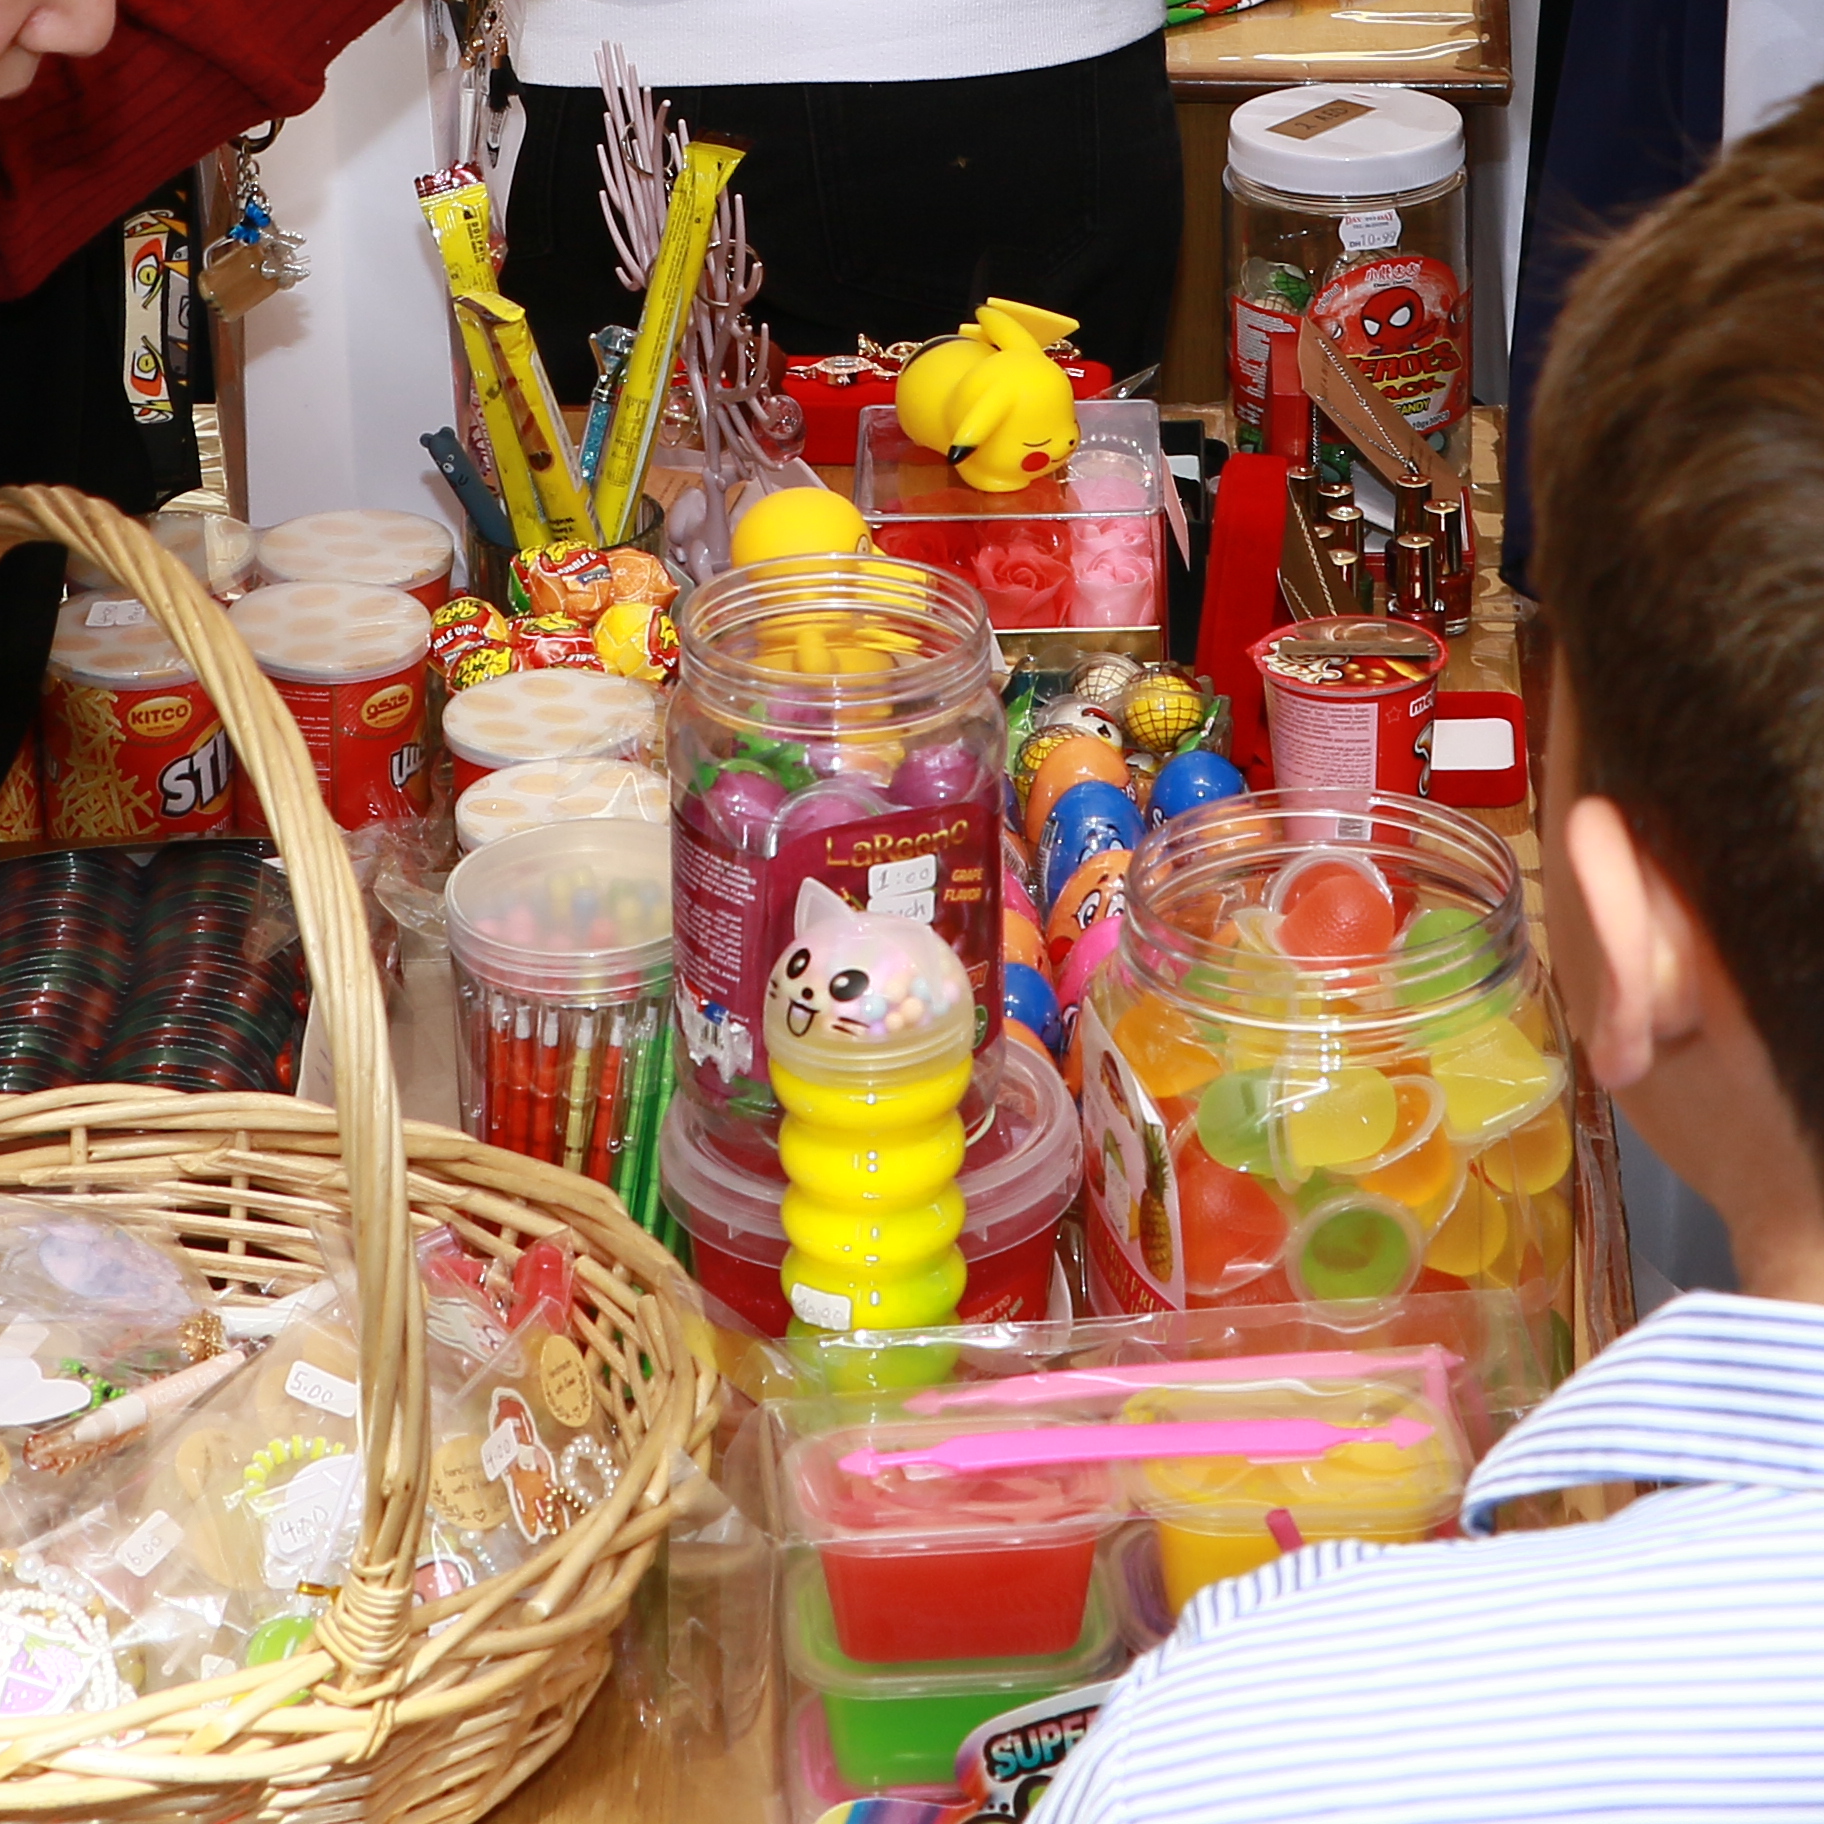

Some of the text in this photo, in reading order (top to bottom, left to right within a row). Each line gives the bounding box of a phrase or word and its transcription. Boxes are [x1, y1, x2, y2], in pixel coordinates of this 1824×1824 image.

[471, 221, 486, 264] DOLPHIN
[129, 703, 189, 724] KITCO
[952, 867, 983, 882] GRAPE
[943, 887, 982, 902] FLAVOR
[289, 1370, 334, 1404] 5.00
